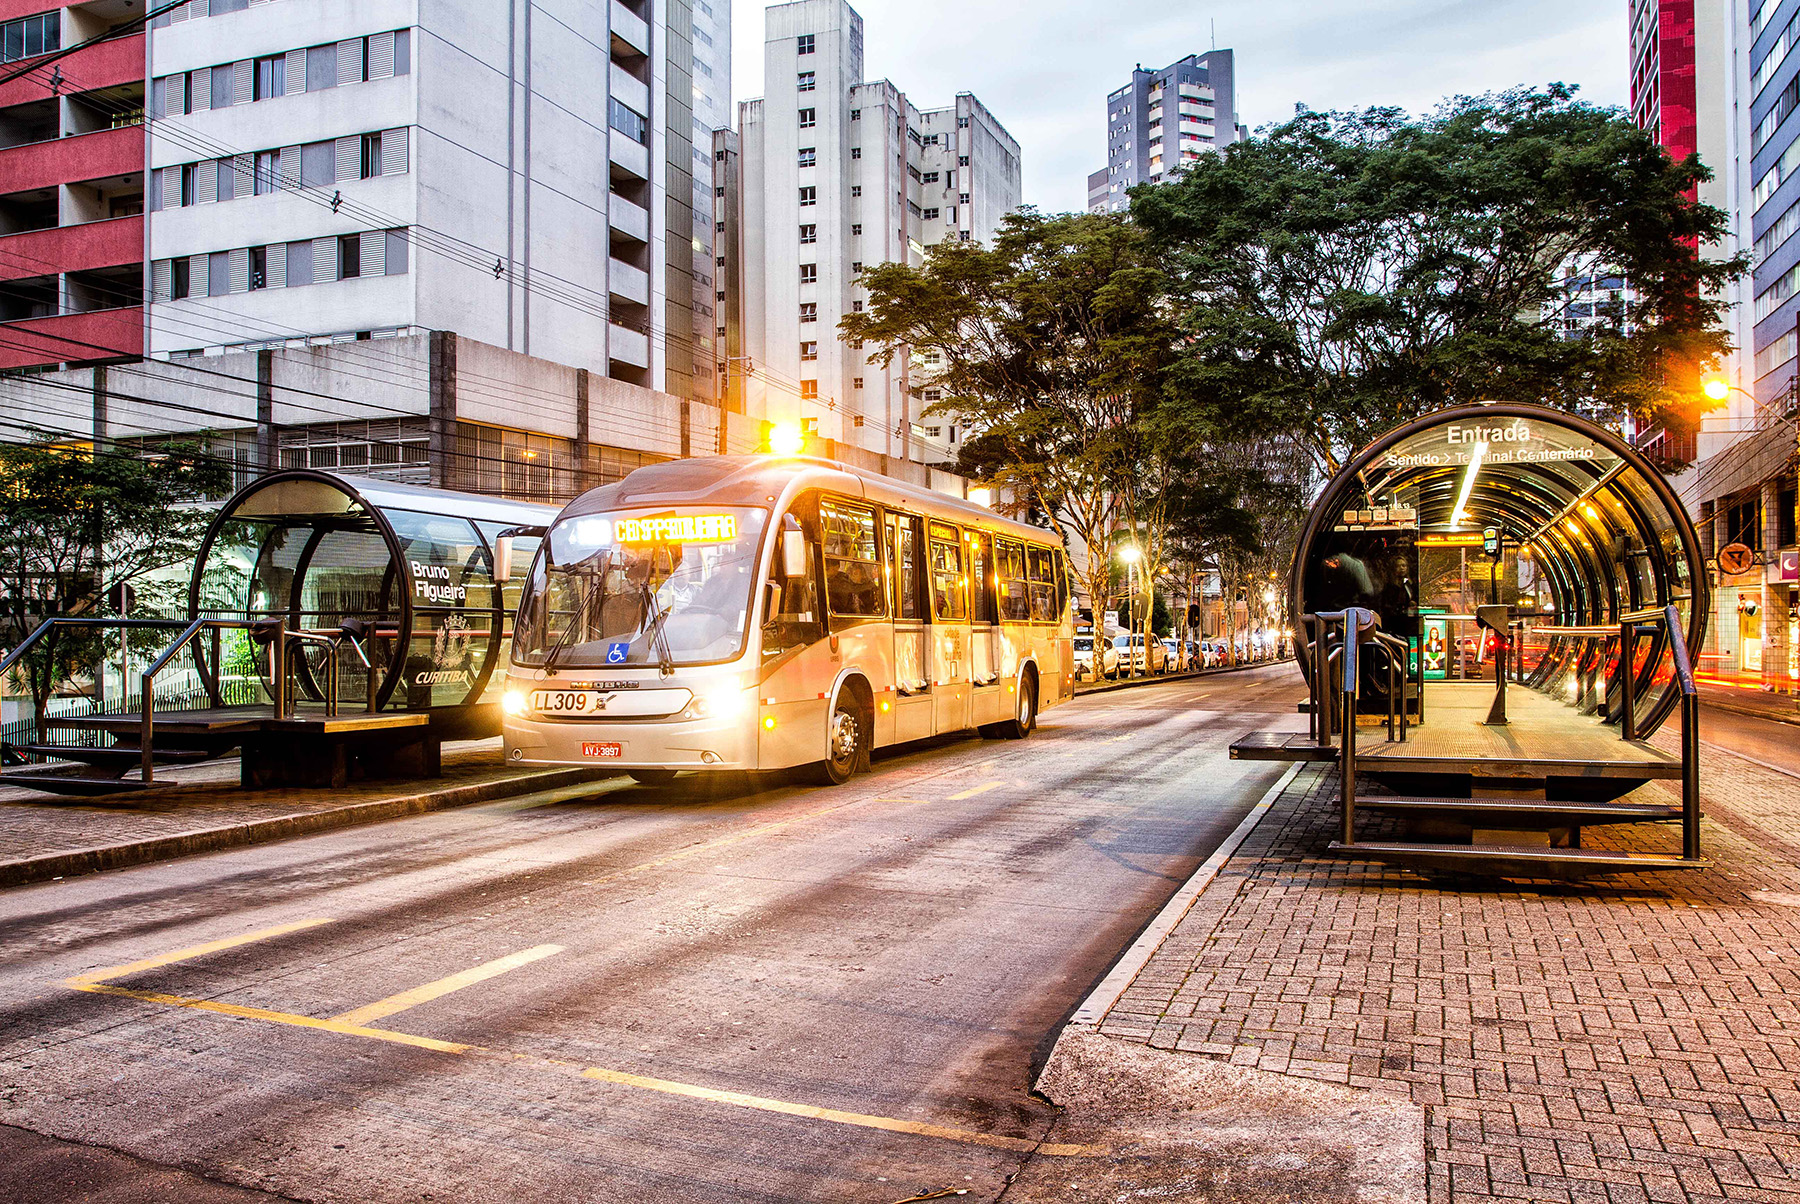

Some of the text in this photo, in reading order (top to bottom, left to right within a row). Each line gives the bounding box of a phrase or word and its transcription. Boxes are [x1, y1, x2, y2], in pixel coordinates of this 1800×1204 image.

[1447, 425, 1530, 444] Entrada
[1388, 446, 1594, 466] Sentido Teminal Centenário
[411, 561, 450, 579] Bruno
[415, 580, 466, 602] Filgueira
[415, 670, 469, 684] CURITIBA
[534, 693, 587, 710] LL309
[584, 746, 619, 756] AVJ-3897
